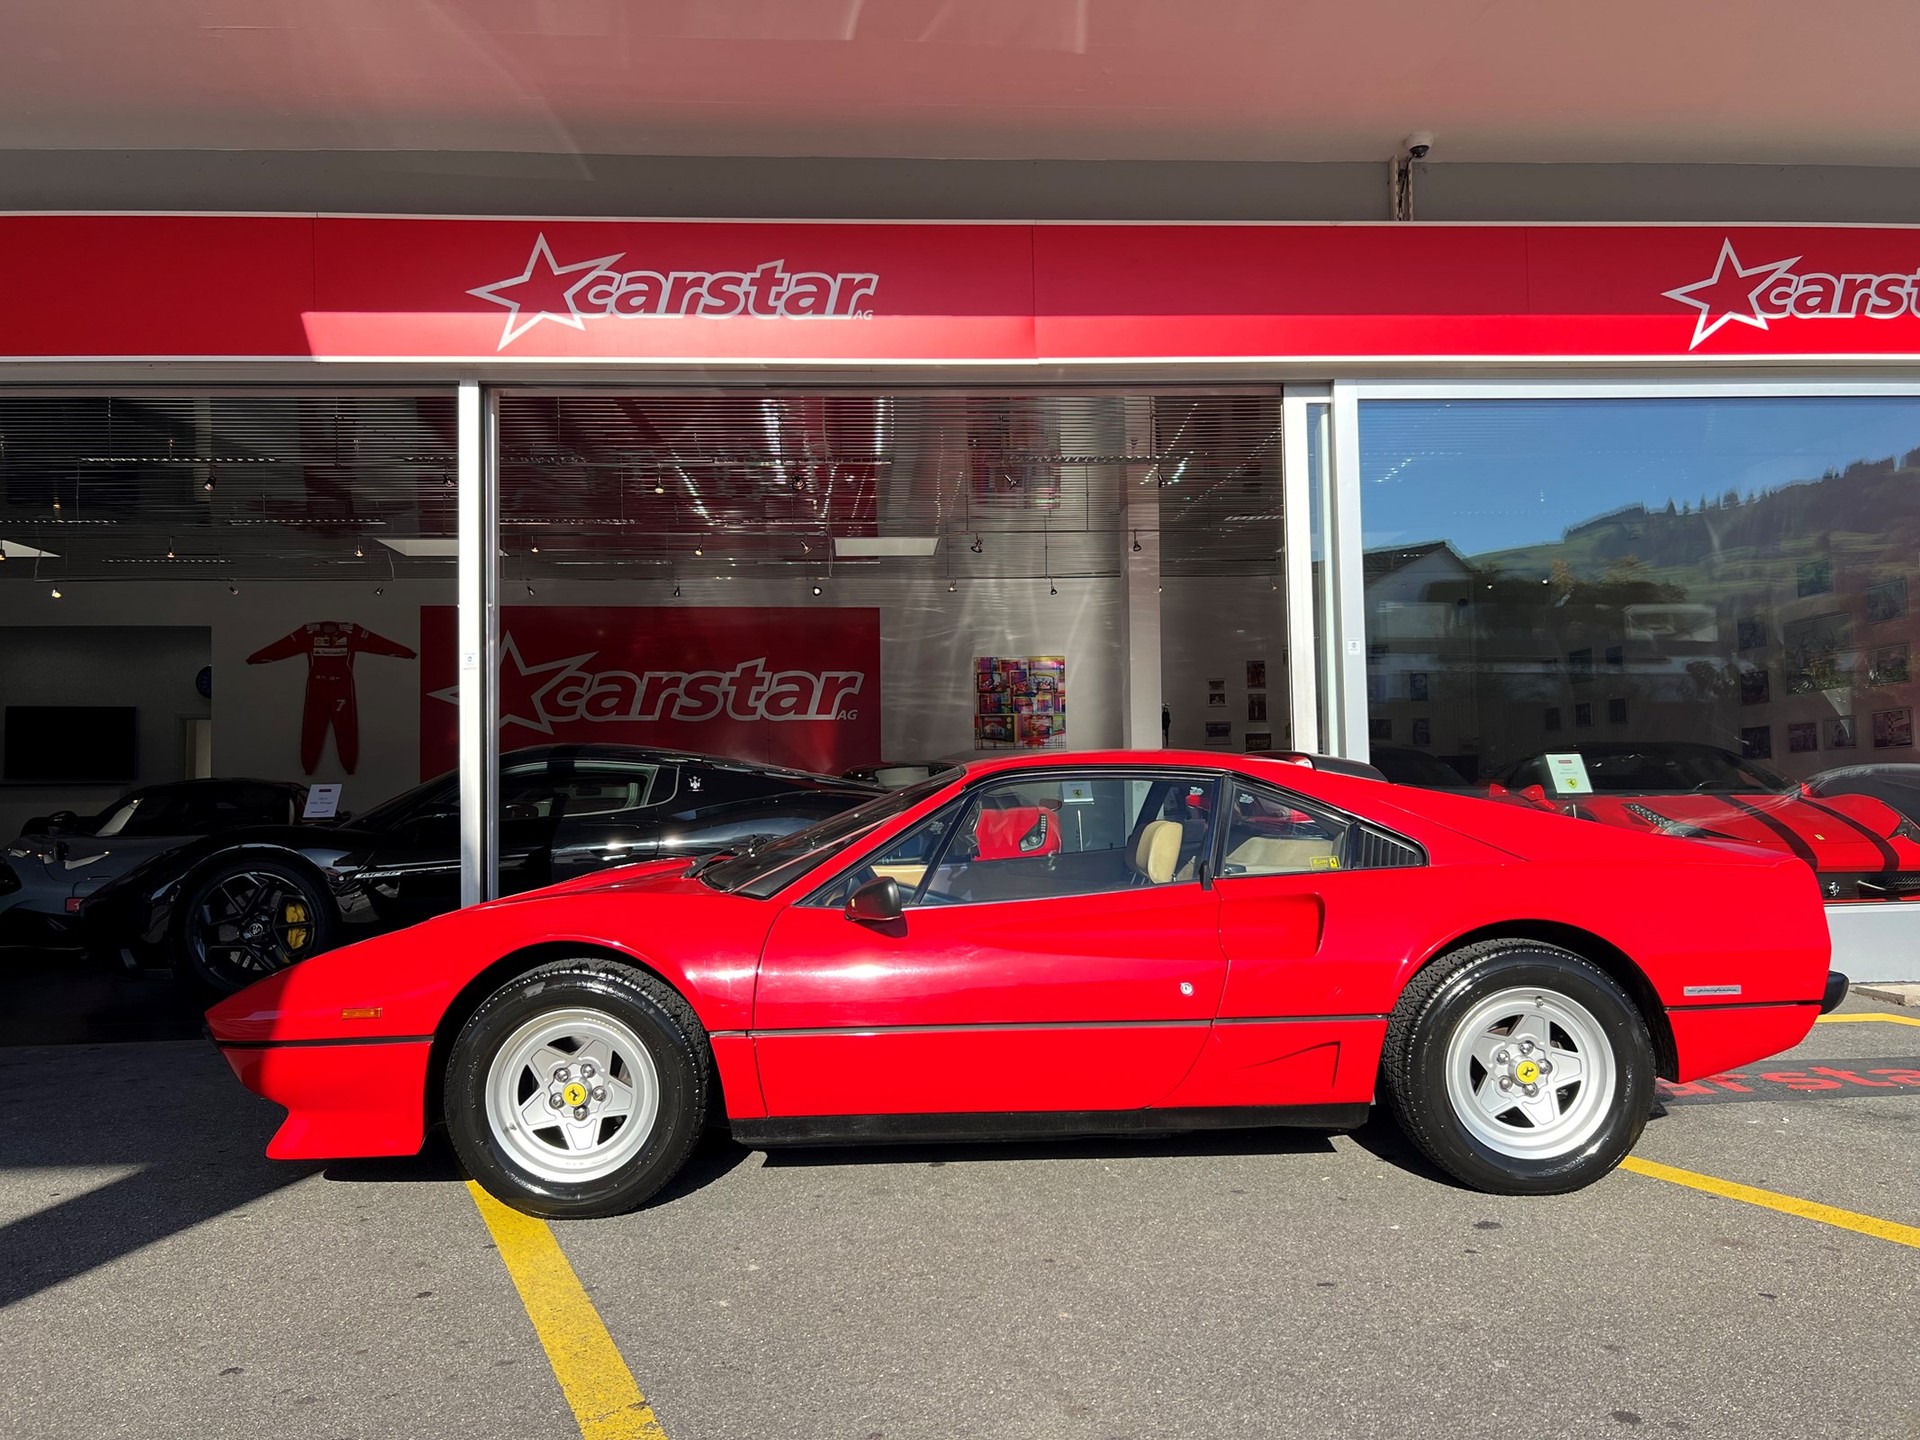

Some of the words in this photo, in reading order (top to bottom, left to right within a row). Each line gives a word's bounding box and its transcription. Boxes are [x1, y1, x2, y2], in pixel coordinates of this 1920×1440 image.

[563, 259, 879, 319] carstar
[853, 310, 874, 320] AG
[336, 699, 346, 712] 7
[531, 657, 865, 722] carstar
[836, 709, 858, 721] AG
